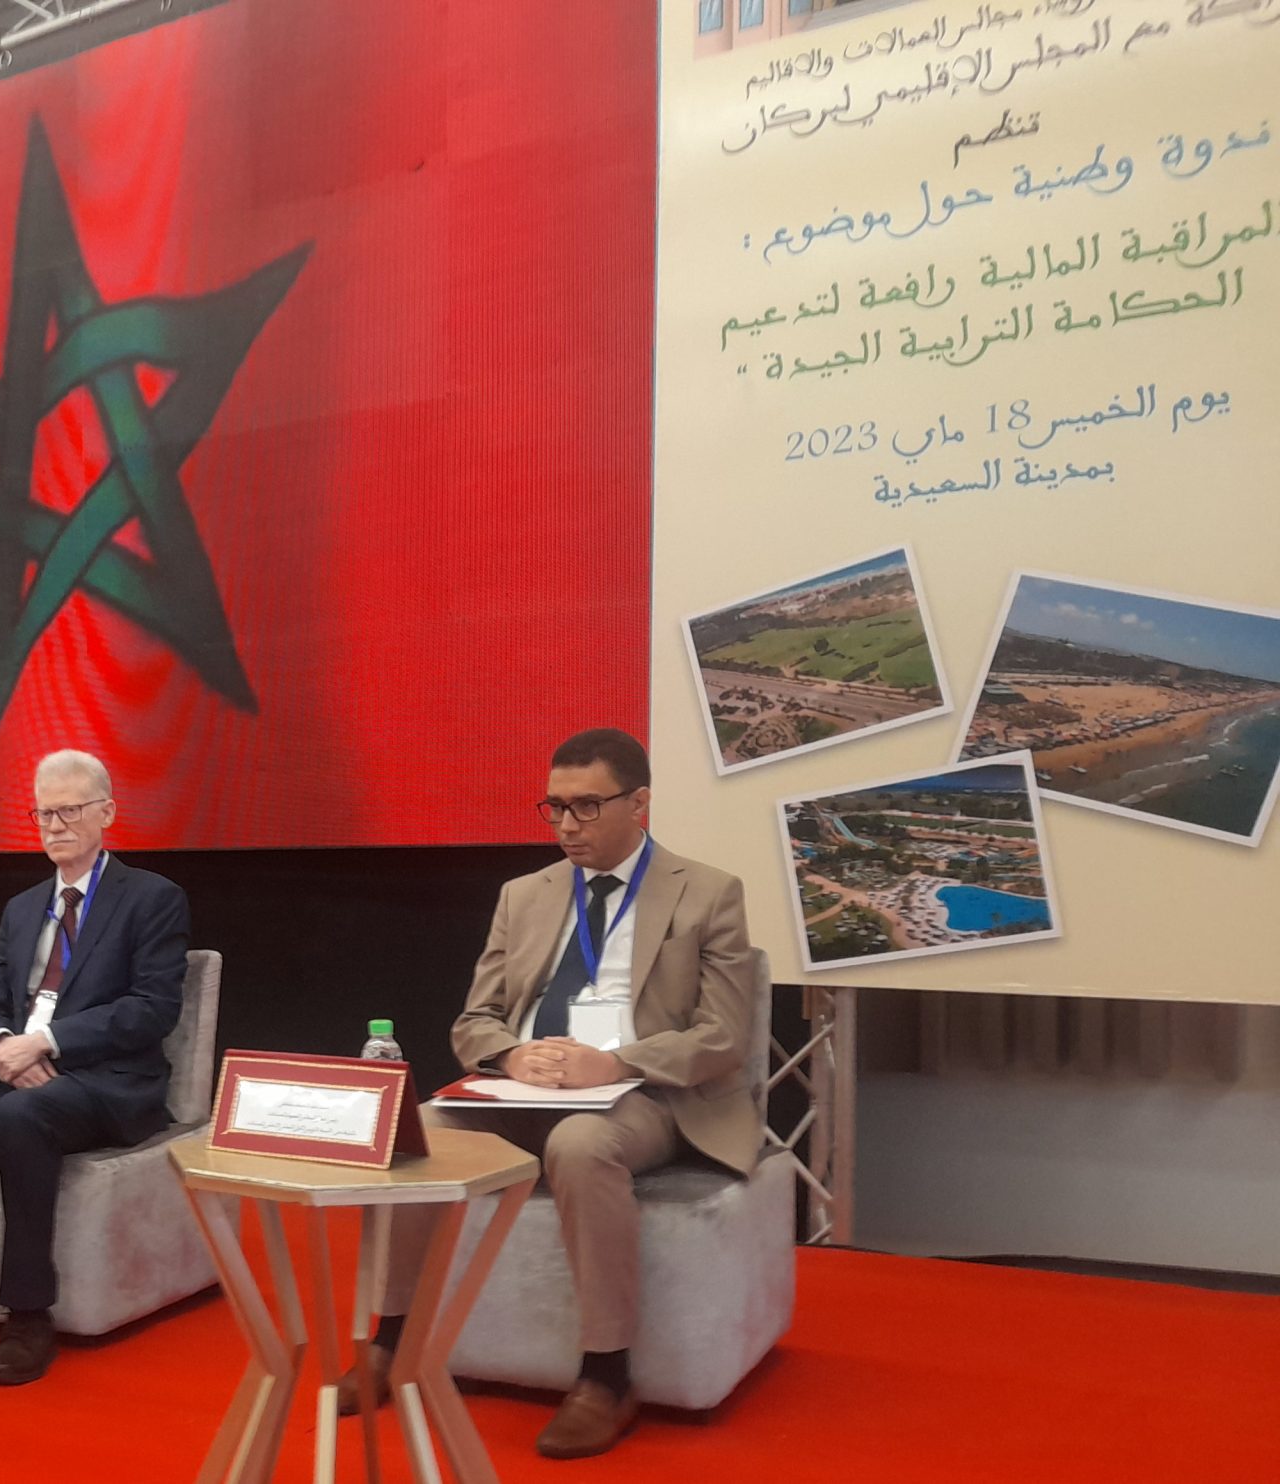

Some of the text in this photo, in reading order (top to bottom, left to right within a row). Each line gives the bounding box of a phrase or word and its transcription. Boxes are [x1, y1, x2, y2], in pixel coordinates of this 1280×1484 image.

[979, 16, 1111, 93] المجلس
[1122, 21, 1170, 52] مع
[721, 83, 851, 153] لبركان
[953, 108, 1041, 169] تنظم
[1014, 143, 1134, 201] وطنية
[1158, 120, 1271, 178] ندوة
[763, 206, 892, 266] موضوع
[884, 181, 994, 238] حول
[721, 199, 1280, 352] لمراقبة المالية رافعة لتدعيم
[1054, 266, 1244, 333] الحكامة
[763, 329, 882, 380] الجيدة
[899, 303, 1034, 367] الترابية
[785, 383, 1231, 465] يوم الخميس 18 ماي 2023
[873, 457, 1115, 508] بمدينة السعيدية
